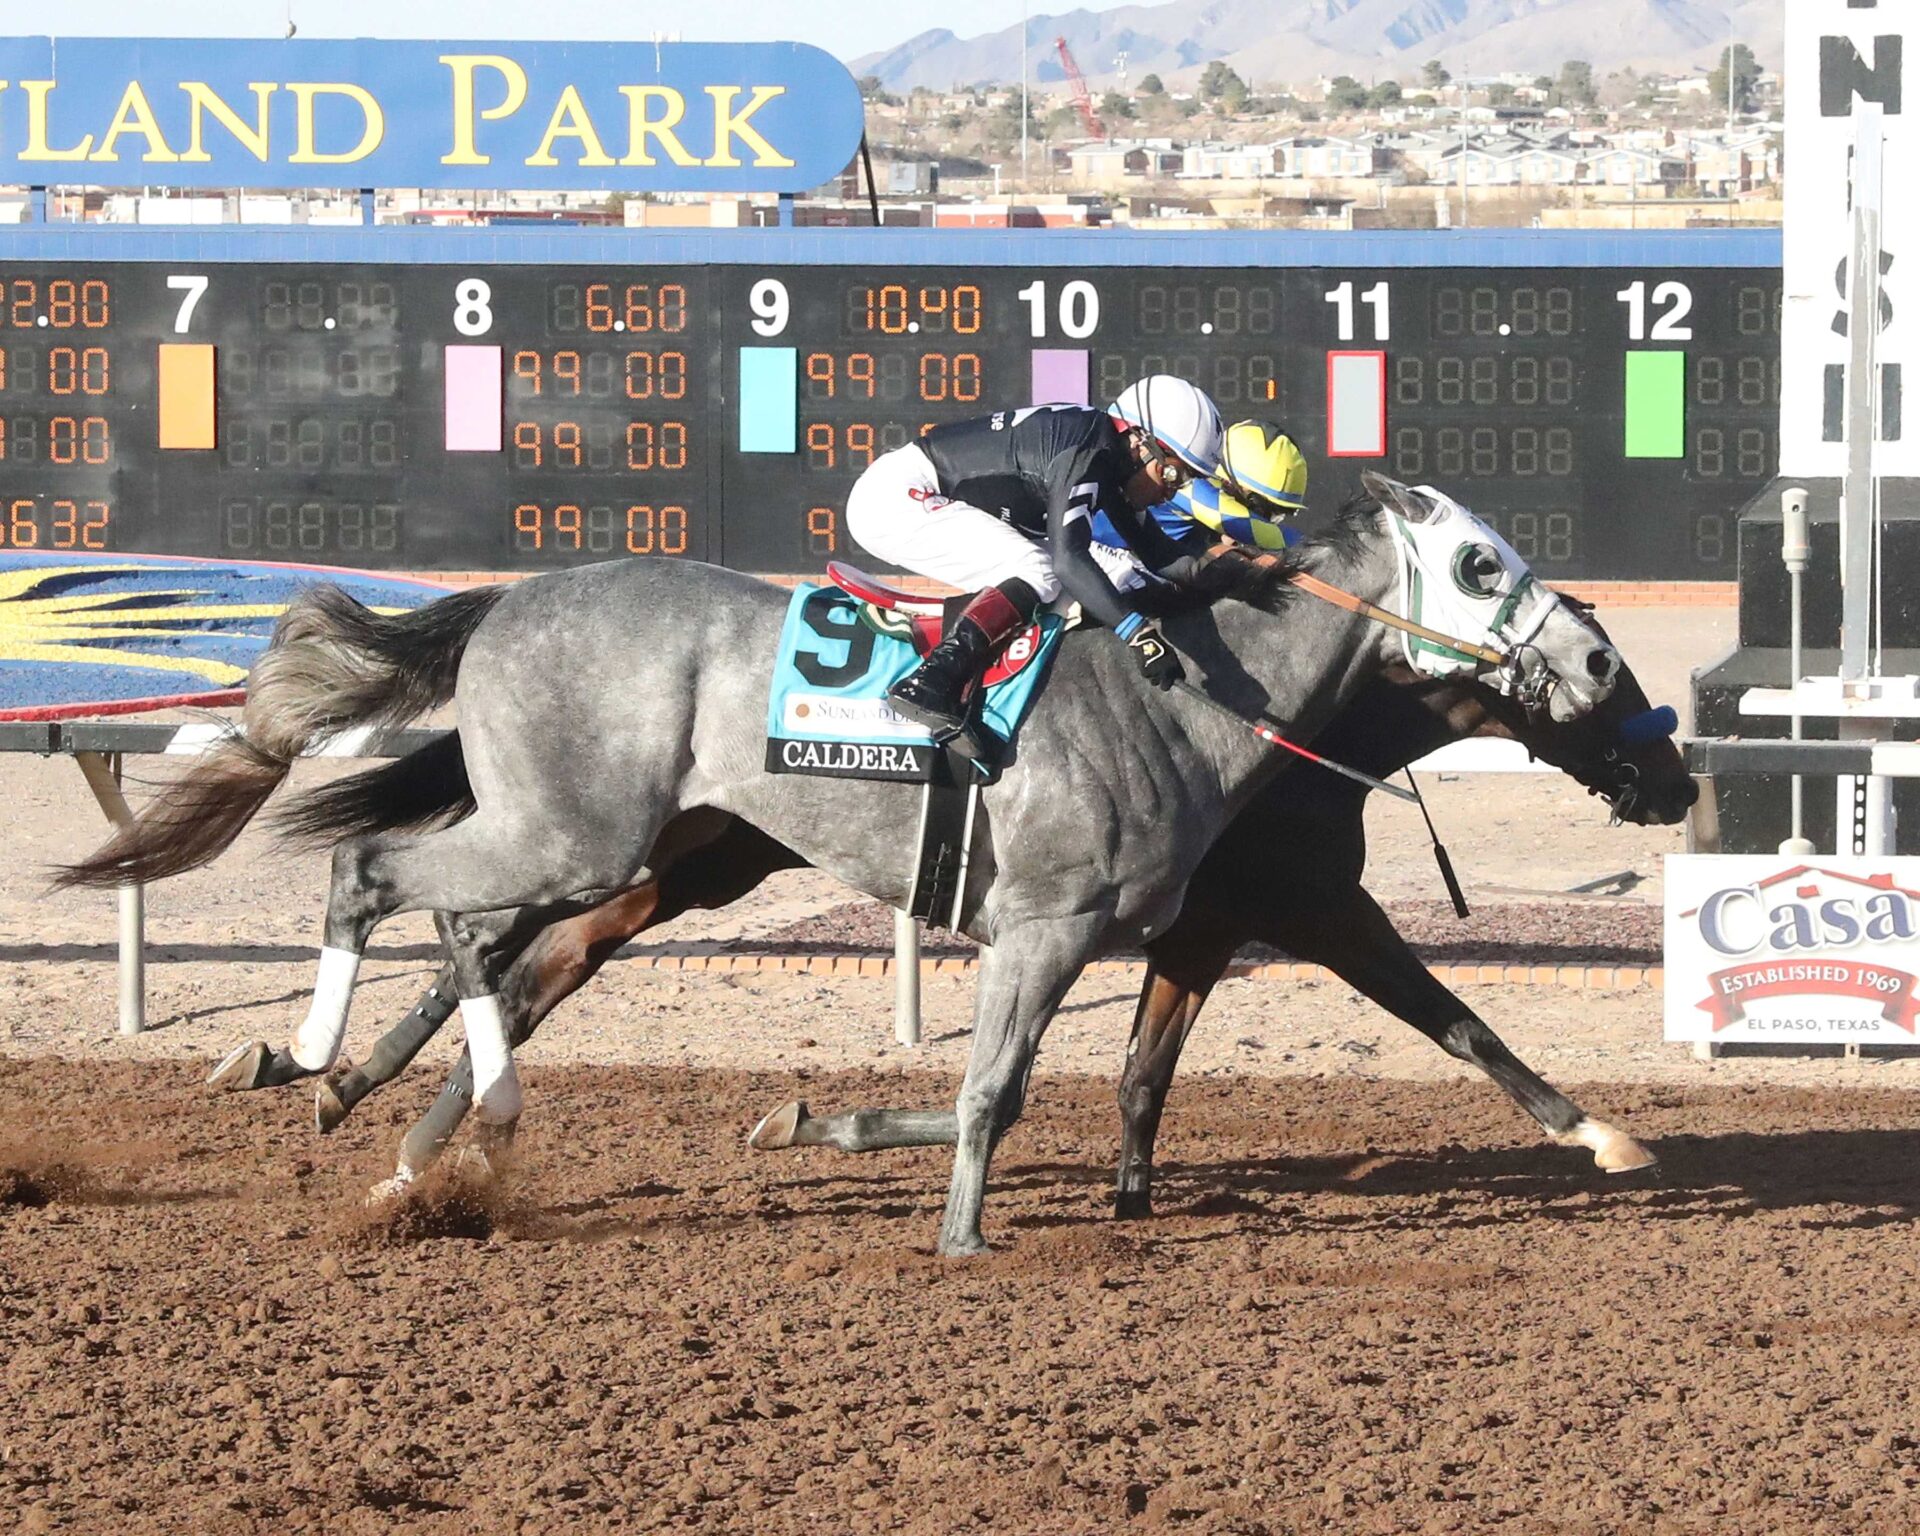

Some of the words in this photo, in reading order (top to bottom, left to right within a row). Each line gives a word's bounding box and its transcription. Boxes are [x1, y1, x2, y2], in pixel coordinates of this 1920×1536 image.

[0, 80, 385, 164] LAND
[440, 55, 796, 168] PARK
[0, 280, 109, 328] 2.80
[166, 275, 209, 334] 7
[453, 277, 494, 337] 8
[586, 284, 687, 333] 6.60
[749, 278, 790, 337] 9
[867, 285, 981, 334] 10.40
[1018, 280, 1099, 339] 10
[1324, 281, 1390, 341] 11
[1616, 281, 1693, 341] 12
[50, 347, 109, 395] 00
[513, 350, 581, 395] 99
[625, 351, 687, 400] 00
[807, 352, 875, 398] 99
[920, 353, 980, 401] 00
[50, 416, 110, 464] 00
[514, 421, 581, 466] 99
[626, 422, 687, 470] 00
[0, 500, 110, 548] 632
[515, 505, 582, 550] 99
[626, 505, 688, 554] 00
[793, 585, 877, 688] 9
[782, 740, 920, 772] CALDERA
[1698, 887, 1917, 955] Casa
[1720, 965, 1849, 995] ESTABLISHED
[1856, 969, 1902, 994] 1969
[1747, 1019, 1767, 1031] EL
[1772, 1018, 1822, 1033] PASO,
[1827, 1019, 1881, 1032] TEXAS
